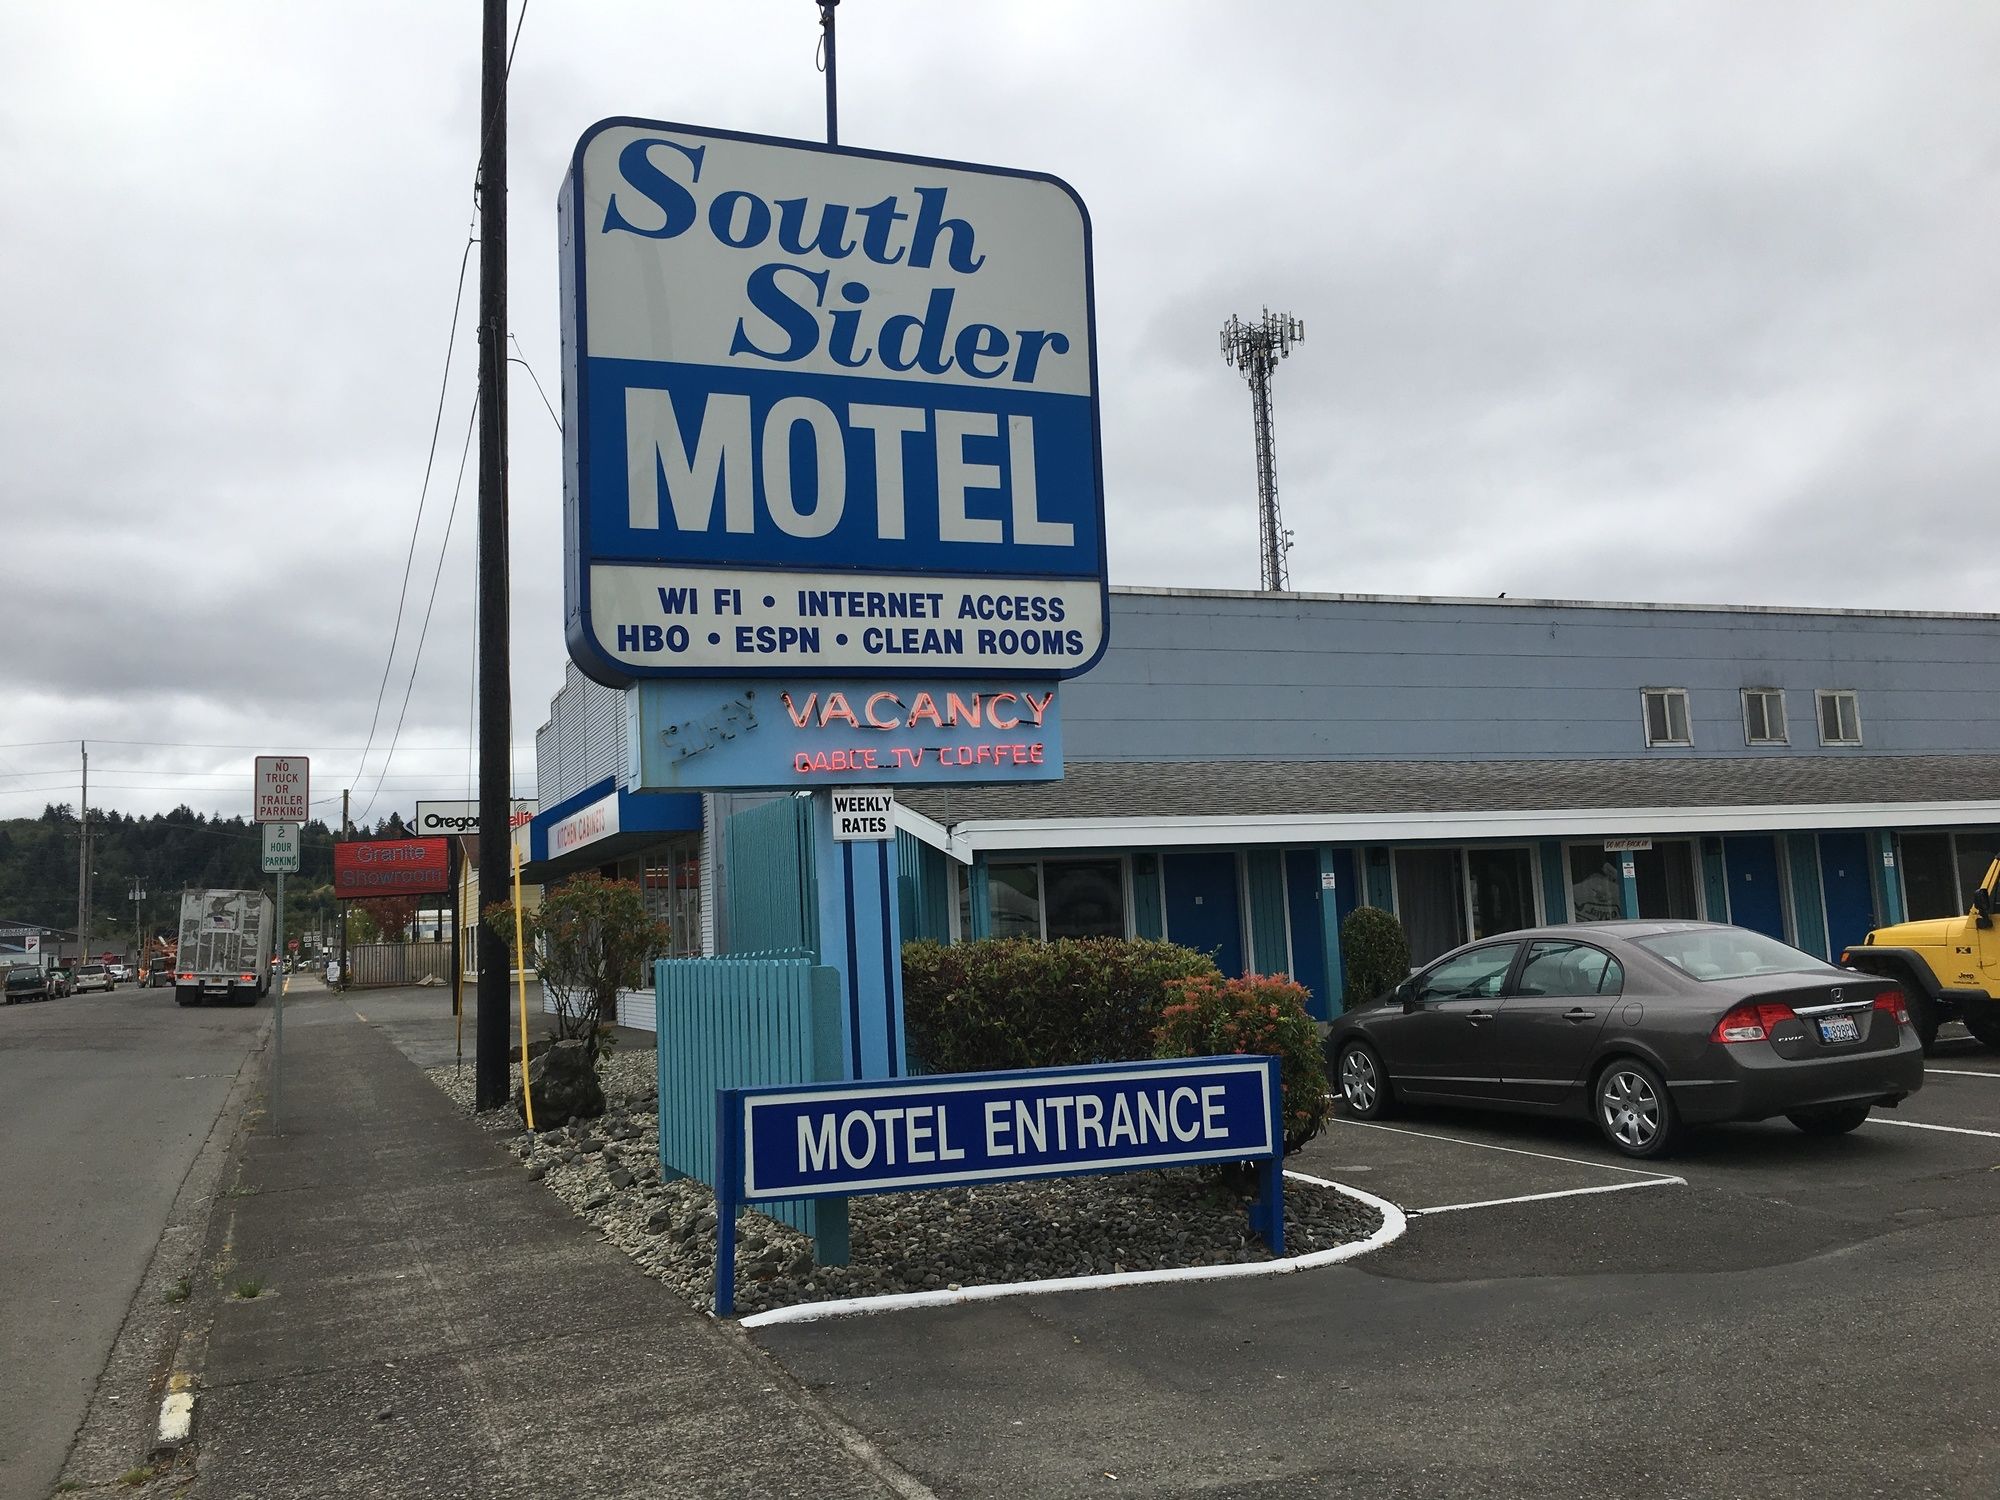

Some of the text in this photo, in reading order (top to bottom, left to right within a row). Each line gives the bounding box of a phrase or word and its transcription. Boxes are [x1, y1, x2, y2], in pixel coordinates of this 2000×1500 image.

[601, 138, 986, 274] South
[729, 262, 1070, 384] Sider
[624, 387, 1075, 547] MOTEL
[657, 587, 1065, 623] WI FI INTERNET ACCESS
[617, 624, 1084, 656] HBO ESPN CLEAN ROOMS
[781, 691, 1054, 731] VACANCY
[891, 747, 924, 768] TV
[939, 743, 1044, 767] COFFEE
[275, 762, 289, 772] NO
[265, 773, 299, 783] TRUCK
[275, 784, 289, 794] OR
[261, 795, 303, 805] TRAILER
[834, 796, 892, 813] WEEKLY
[260, 806, 303, 816] PARKING
[841, 816, 887, 833] RATES
[278, 829, 285, 838] 2
[270, 842, 292, 852] HOUR
[355, 844, 426, 863] Granite
[265, 855, 297, 867] PARKING
[342, 868, 442, 887] Showroom
[1958, 972, 1975, 980] Jeep
[797, 1085, 1229, 1173] MOTEL ENTRANCE
